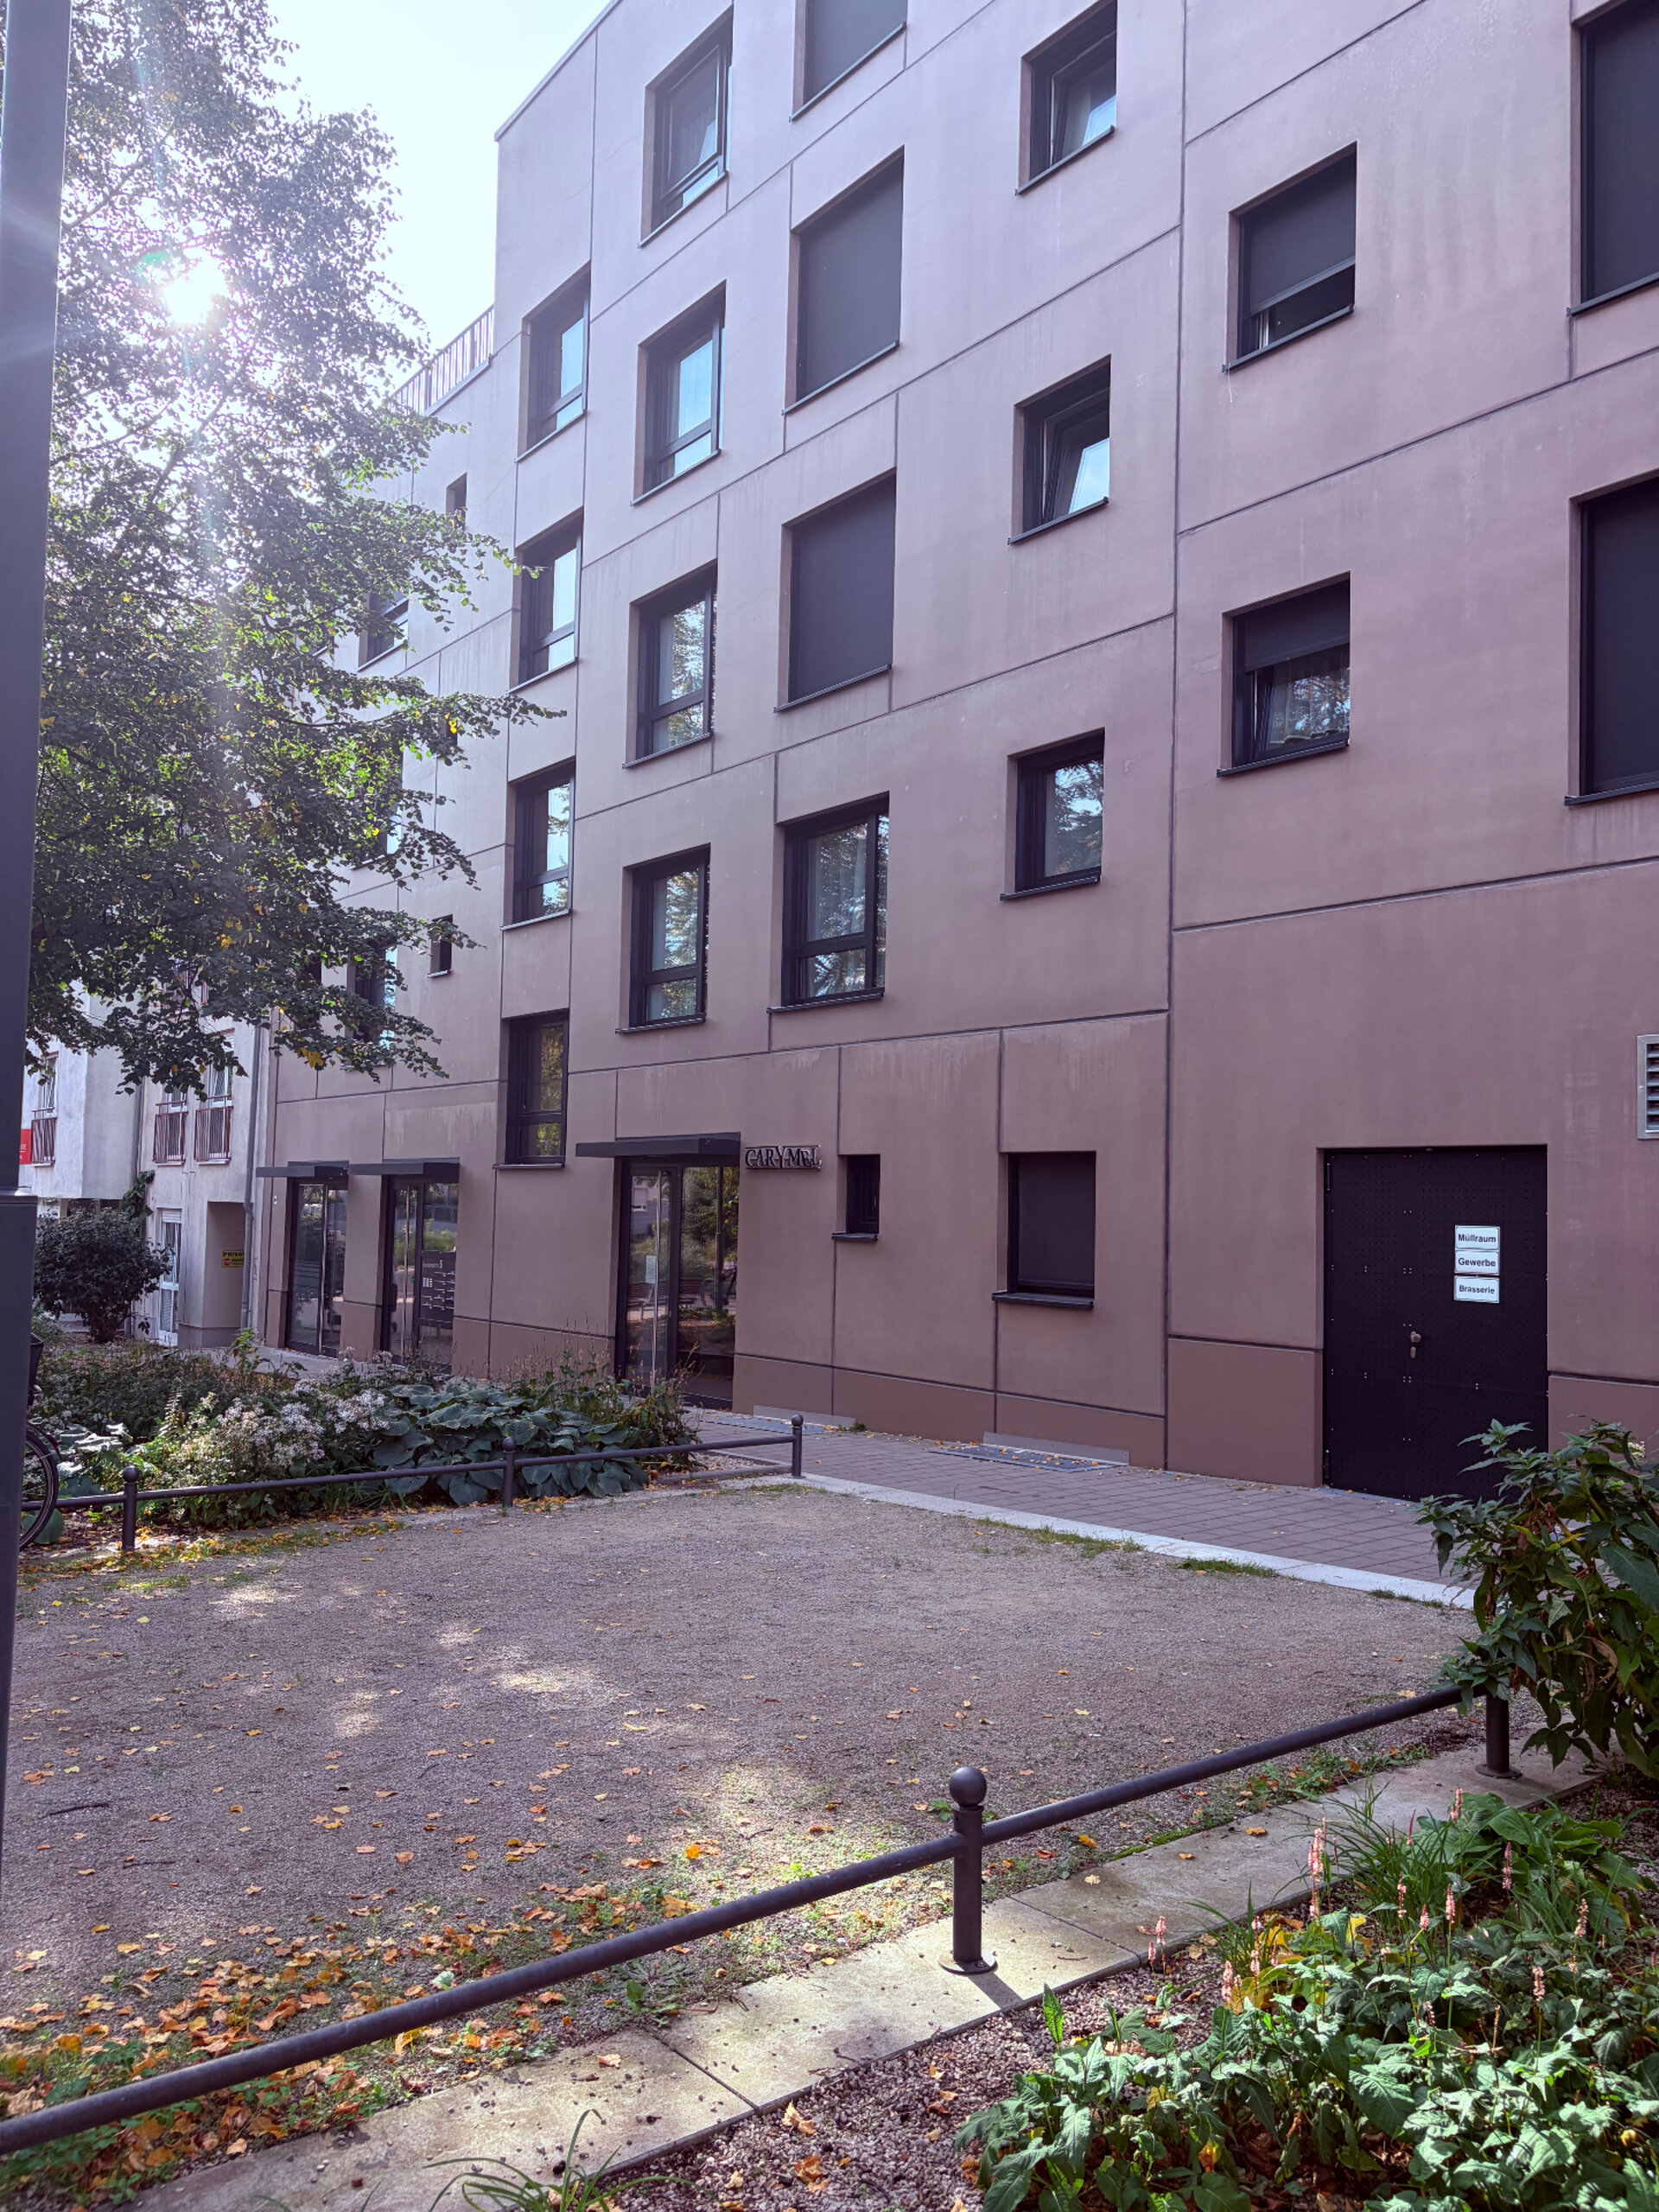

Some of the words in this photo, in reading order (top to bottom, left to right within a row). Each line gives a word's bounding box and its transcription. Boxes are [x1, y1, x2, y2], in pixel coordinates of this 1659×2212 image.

[1458, 1234, 1497, 1243] Müllraum
[1458, 1257, 1497, 1267] Gewerbe
[1459, 1285, 1496, 1294] Brasserie
